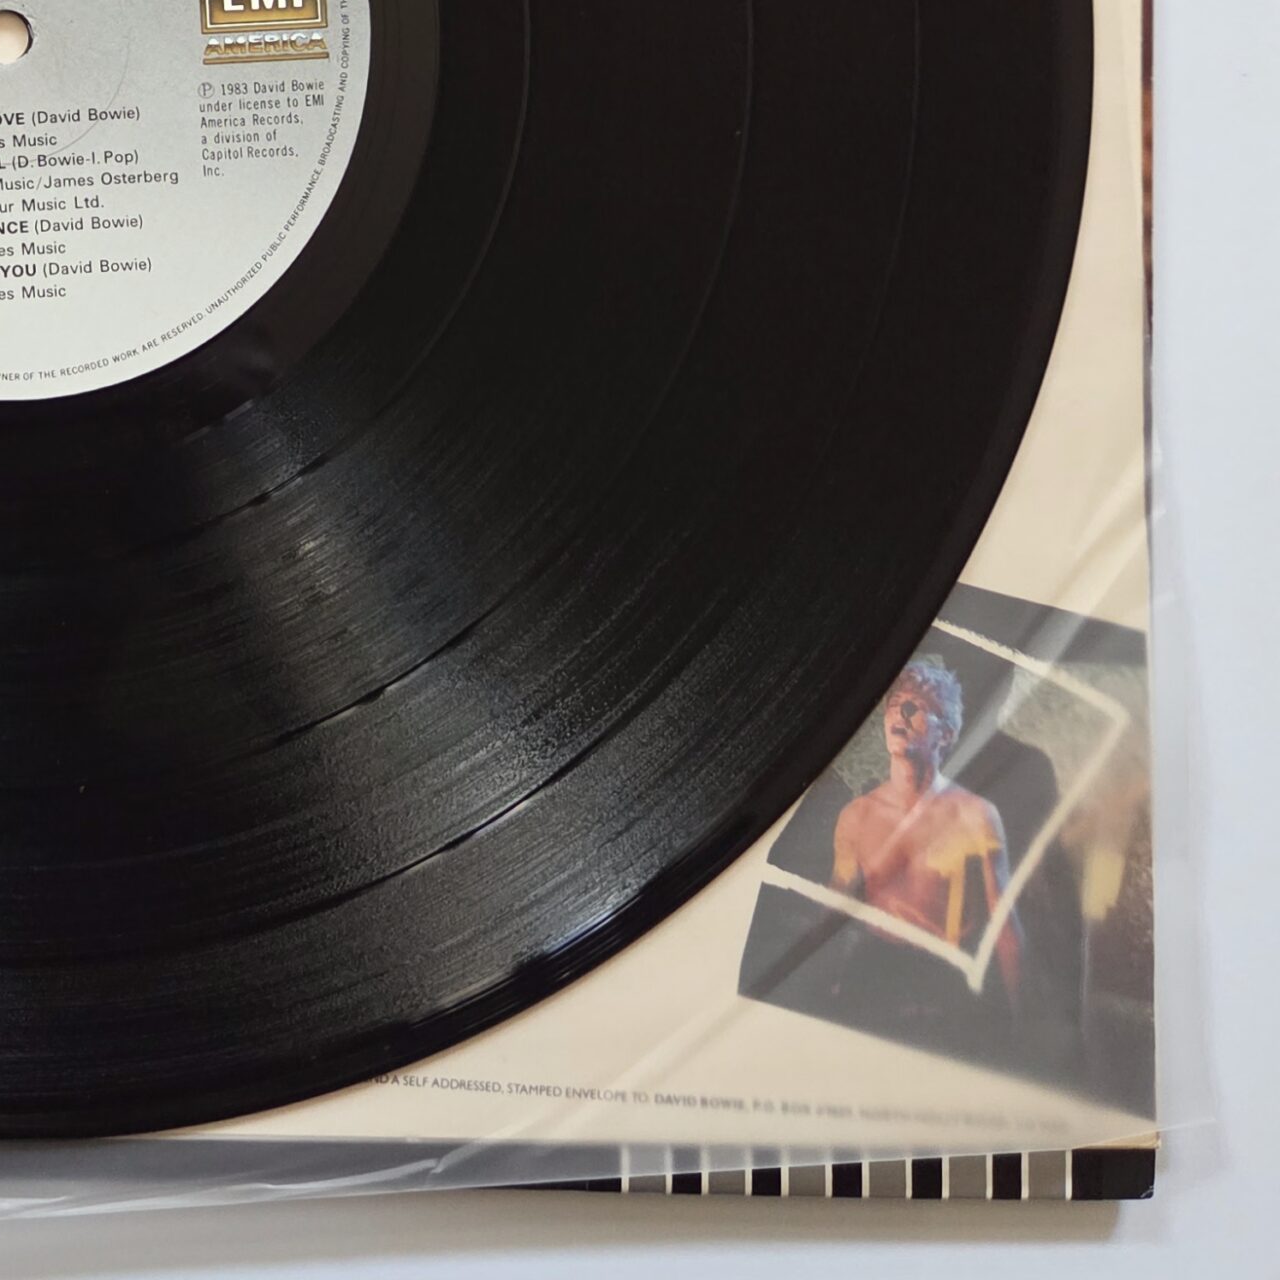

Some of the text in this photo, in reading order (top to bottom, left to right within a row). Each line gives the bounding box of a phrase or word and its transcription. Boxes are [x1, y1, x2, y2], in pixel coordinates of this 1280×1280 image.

[204, 31, 328, 56] AMERICA
[221, 83, 248, 95] 1983
[254, 81, 285, 94] David
[292, 80, 324, 91] Bowie
[200, 94, 324, 112] under license to EMI
[32, 109, 80, 127] (David
[88, 106, 140, 121] Bowie)
[201, 117, 245, 128] America
[13, 133, 57, 147] Music
[201, 129, 276, 145] a division of
[202, 147, 243, 162] Capitol
[101, 170, 178, 185] Osterberg
[202, 164, 225, 177] Inc.
[22, 197, 66, 212] Music
[74, 195, 104, 209] Ltd.
[35, 217, 83, 235] (David
[91, 214, 142, 229] Bowie)
[21, 241, 66, 255] Music
[0, 264, 36, 278] YOU
[43, 261, 92, 278] (David
[100, 257, 151, 272] Bowie)
[22, 284, 66, 299] Music
[22, 371, 34, 381] OF
[38, 368, 56, 380] THE
[59, 357, 110, 377] RECORDED
[111, 346, 140, 365] WORK
[139, 337, 160, 353] ARE
[391, 1075, 400, 1086] A
[403, 1075, 429, 1088] SELF
[507, 1082, 562, 1097] STAMPED
[565, 1087, 627, 1103] ENVELOPE
[654, 1093, 697, 1108] DAVID
